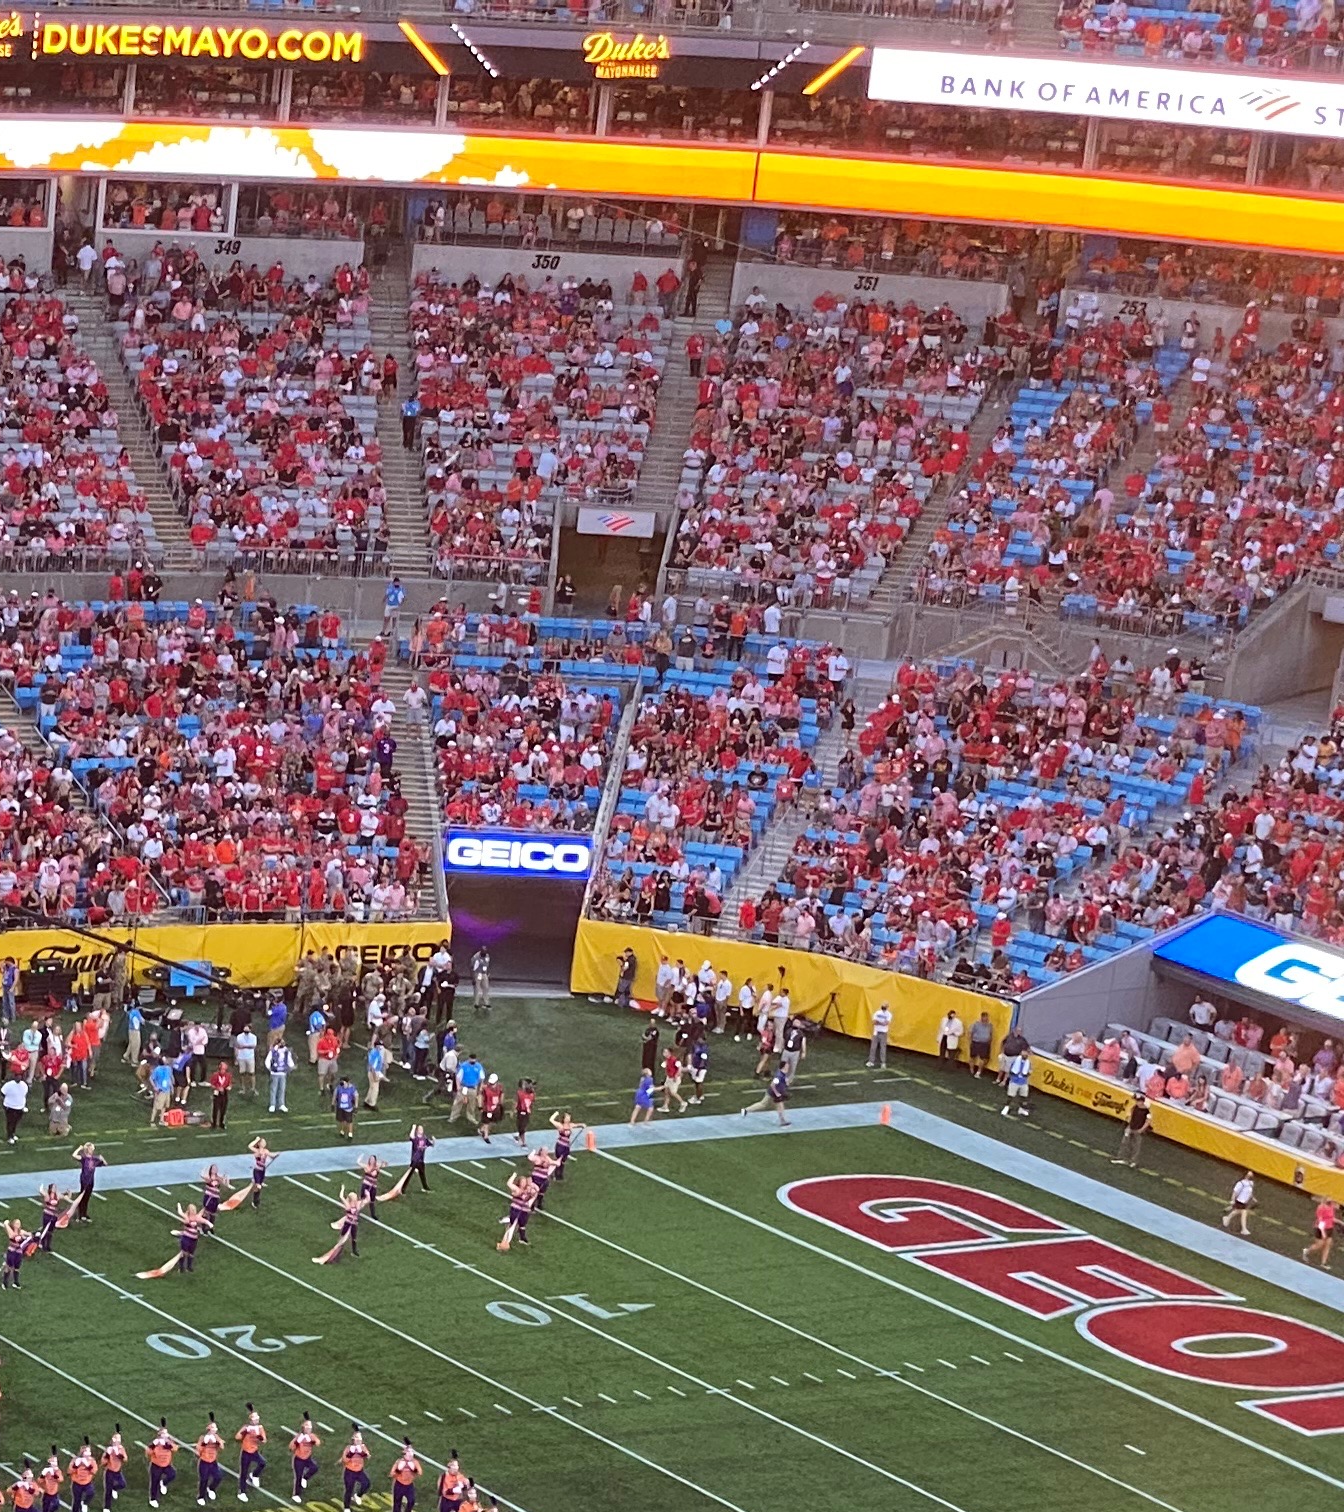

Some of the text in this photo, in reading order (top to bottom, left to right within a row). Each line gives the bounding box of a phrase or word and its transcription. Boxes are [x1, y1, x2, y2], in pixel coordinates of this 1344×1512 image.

[42, 24, 363, 62] DUKESMAYO.COM
[582, 32, 670, 62] Duke's
[595, 64, 658, 79] MAYONNAISE
[940, 74, 1026, 100] BANK
[1038, 82, 1076, 103] OF
[1086, 87, 1226, 116] AMERICA
[214, 240, 242, 255] 349
[531, 254, 561, 270] 350
[854, 275, 880, 291] 351
[448, 838, 590, 872] GEICO
[484, 1293, 630, 1327] 10
[145, 1324, 287, 1360] 20
